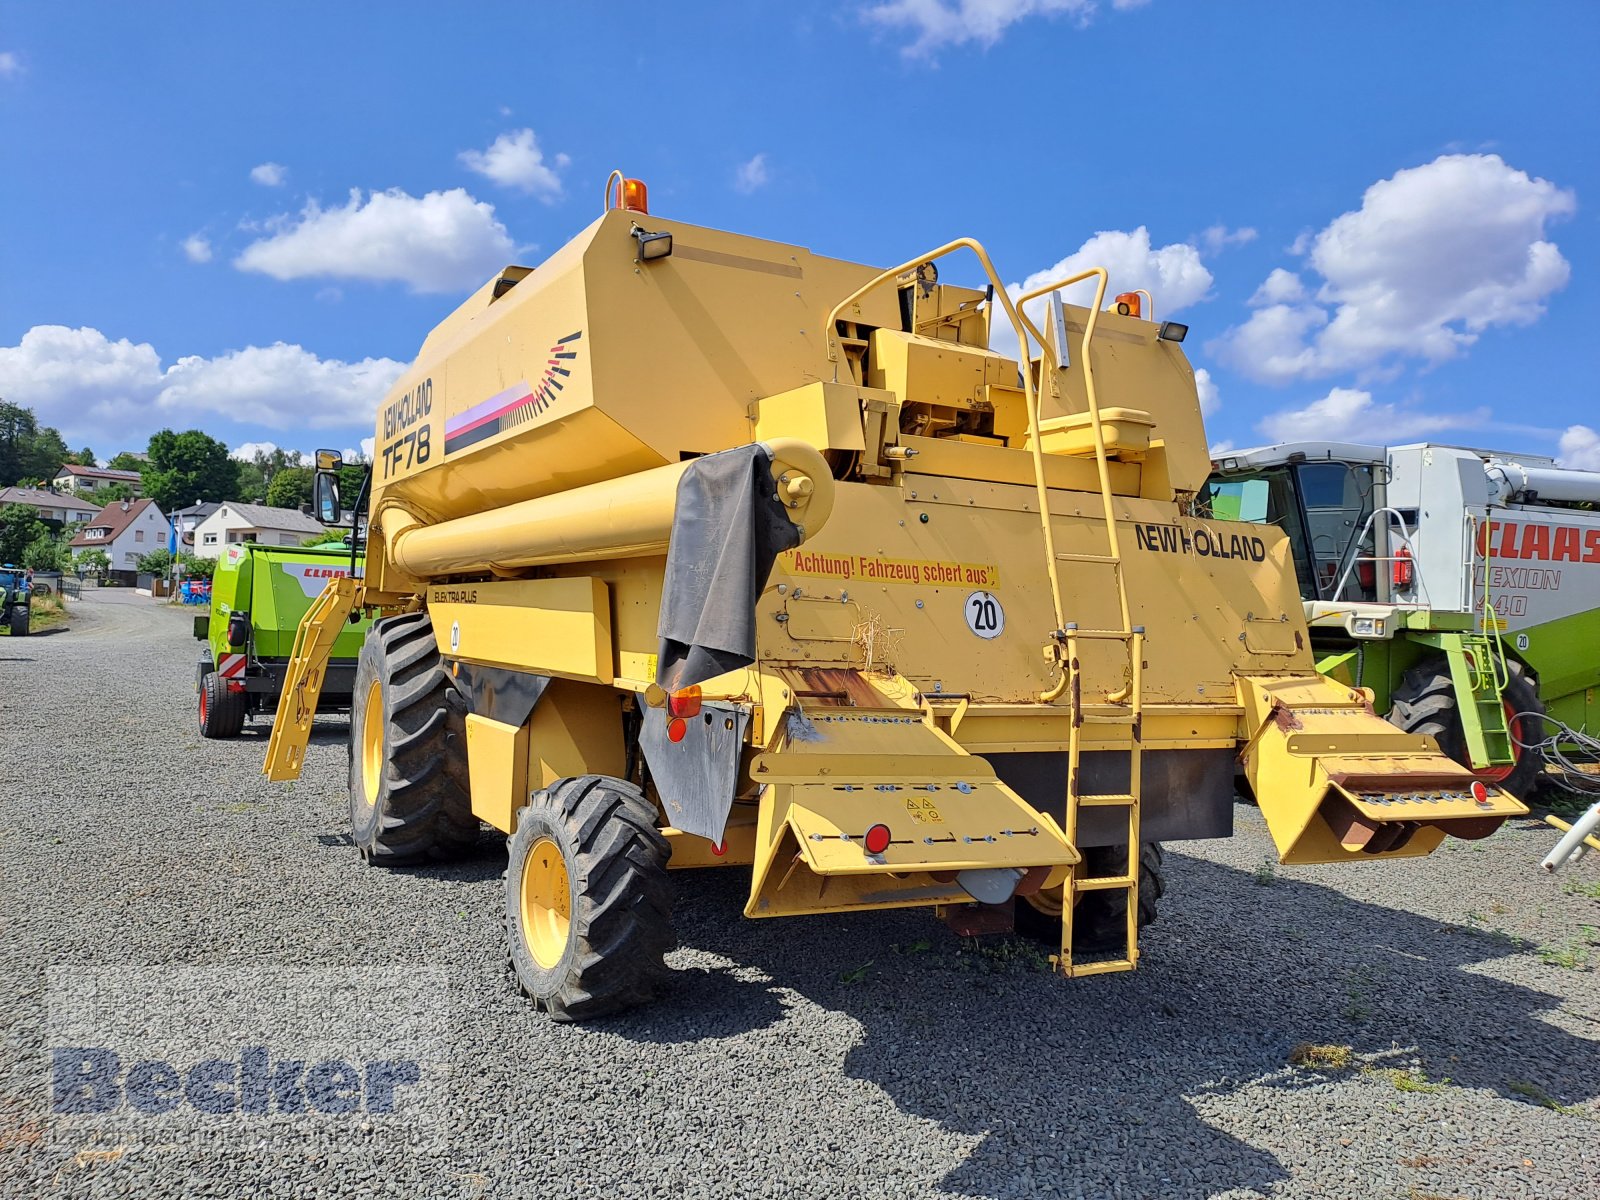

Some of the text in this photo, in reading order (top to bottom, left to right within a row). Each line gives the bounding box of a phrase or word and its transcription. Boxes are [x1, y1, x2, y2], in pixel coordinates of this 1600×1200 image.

[383, 378, 432, 442] NEW HOLLAND
[382, 423, 431, 480] TF78
[1134, 524, 1266, 562] NEW HOLLAND
[1476, 521, 1600, 563] CLAAS
[859, 557, 920, 584] Fahrzeug
[923, 563, 963, 582] schert
[1475, 565, 1561, 590] LEXION
[434, 590, 477, 604] ELEKTRA PLUS
[972, 599, 997, 630] 20
[1518, 635, 1527, 648] 20
